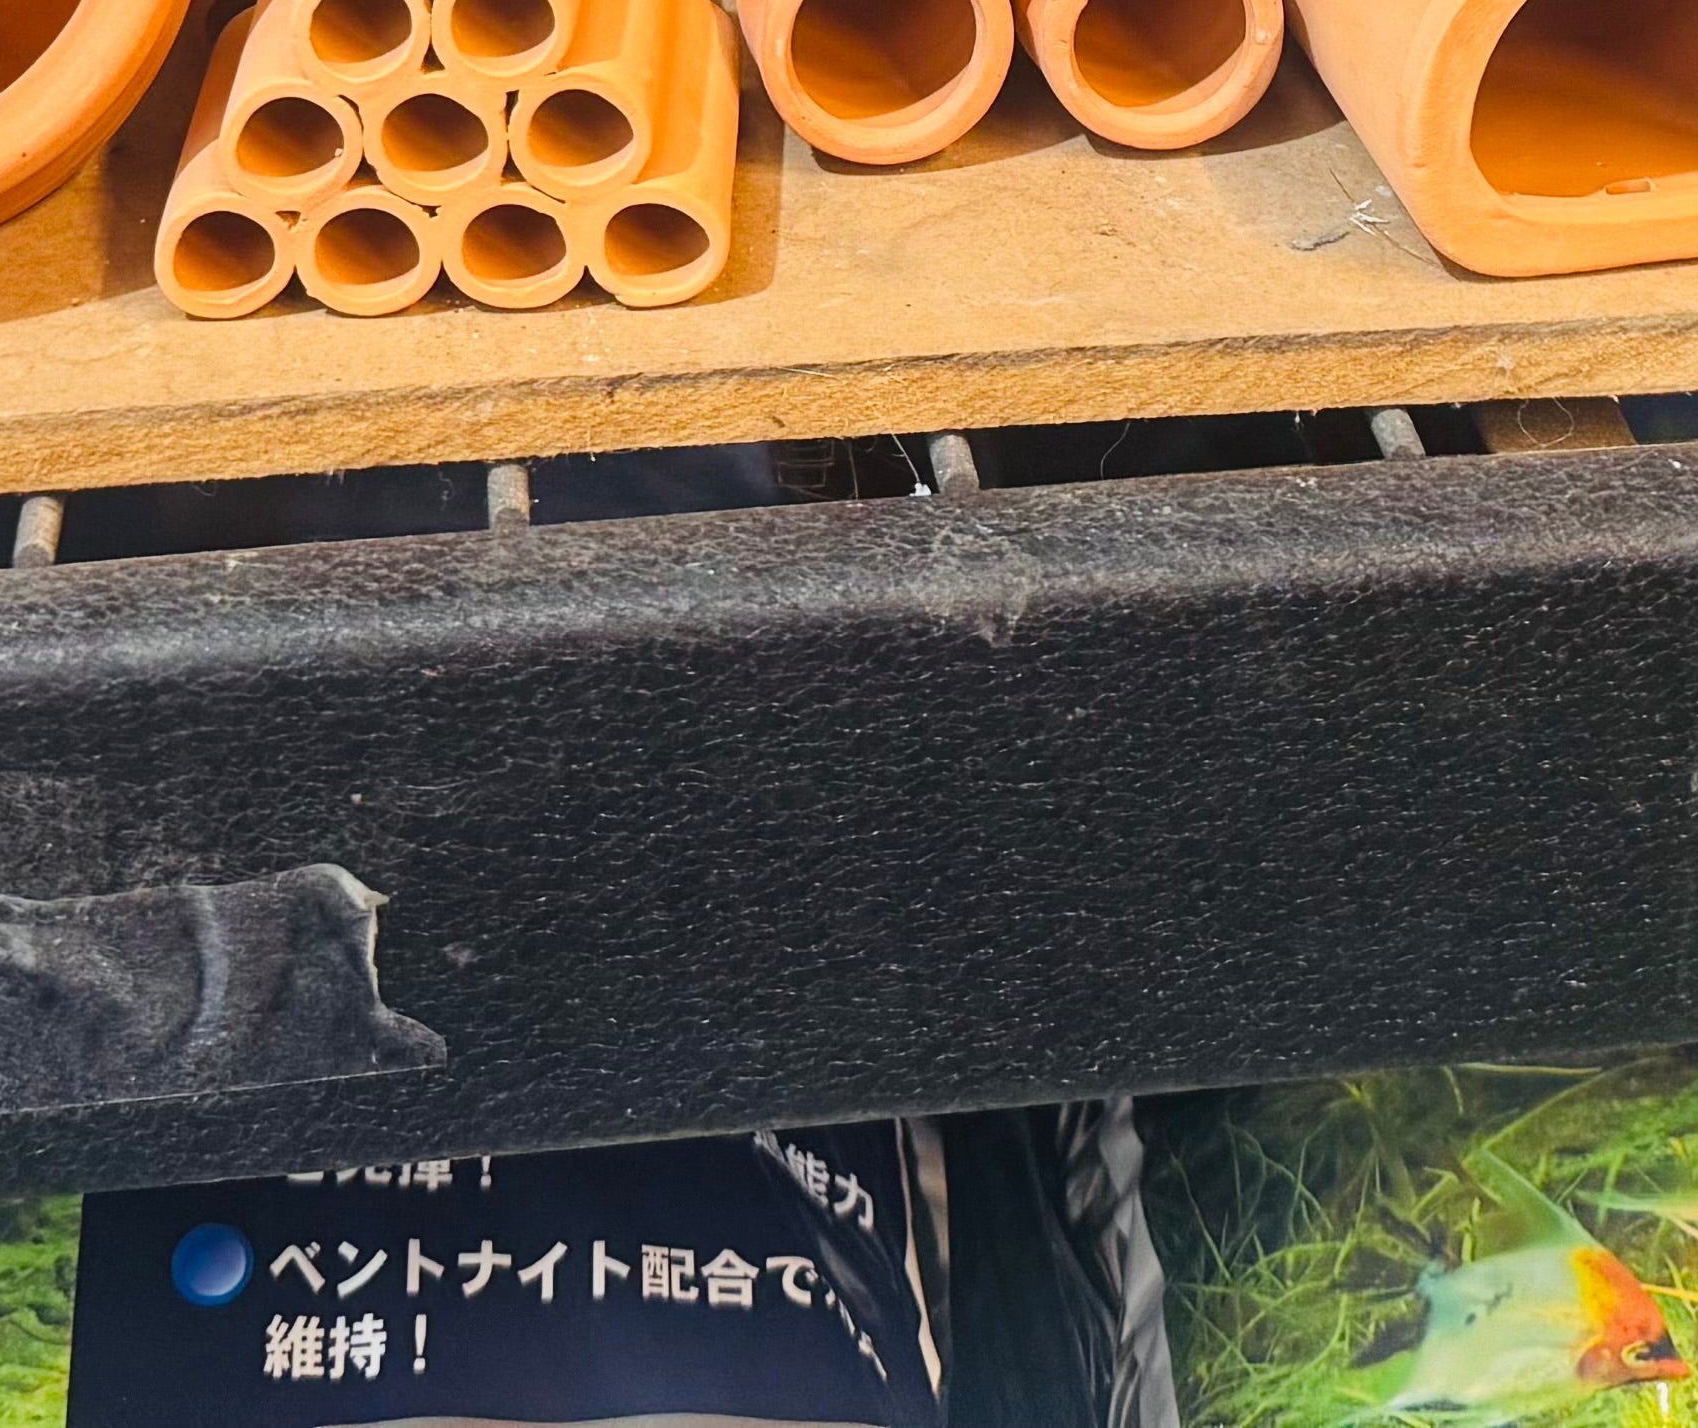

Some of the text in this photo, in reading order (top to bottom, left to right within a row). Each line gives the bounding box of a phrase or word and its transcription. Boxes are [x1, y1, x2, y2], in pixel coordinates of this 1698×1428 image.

[269, 1237, 837, 1308] ベントナイト配合で
